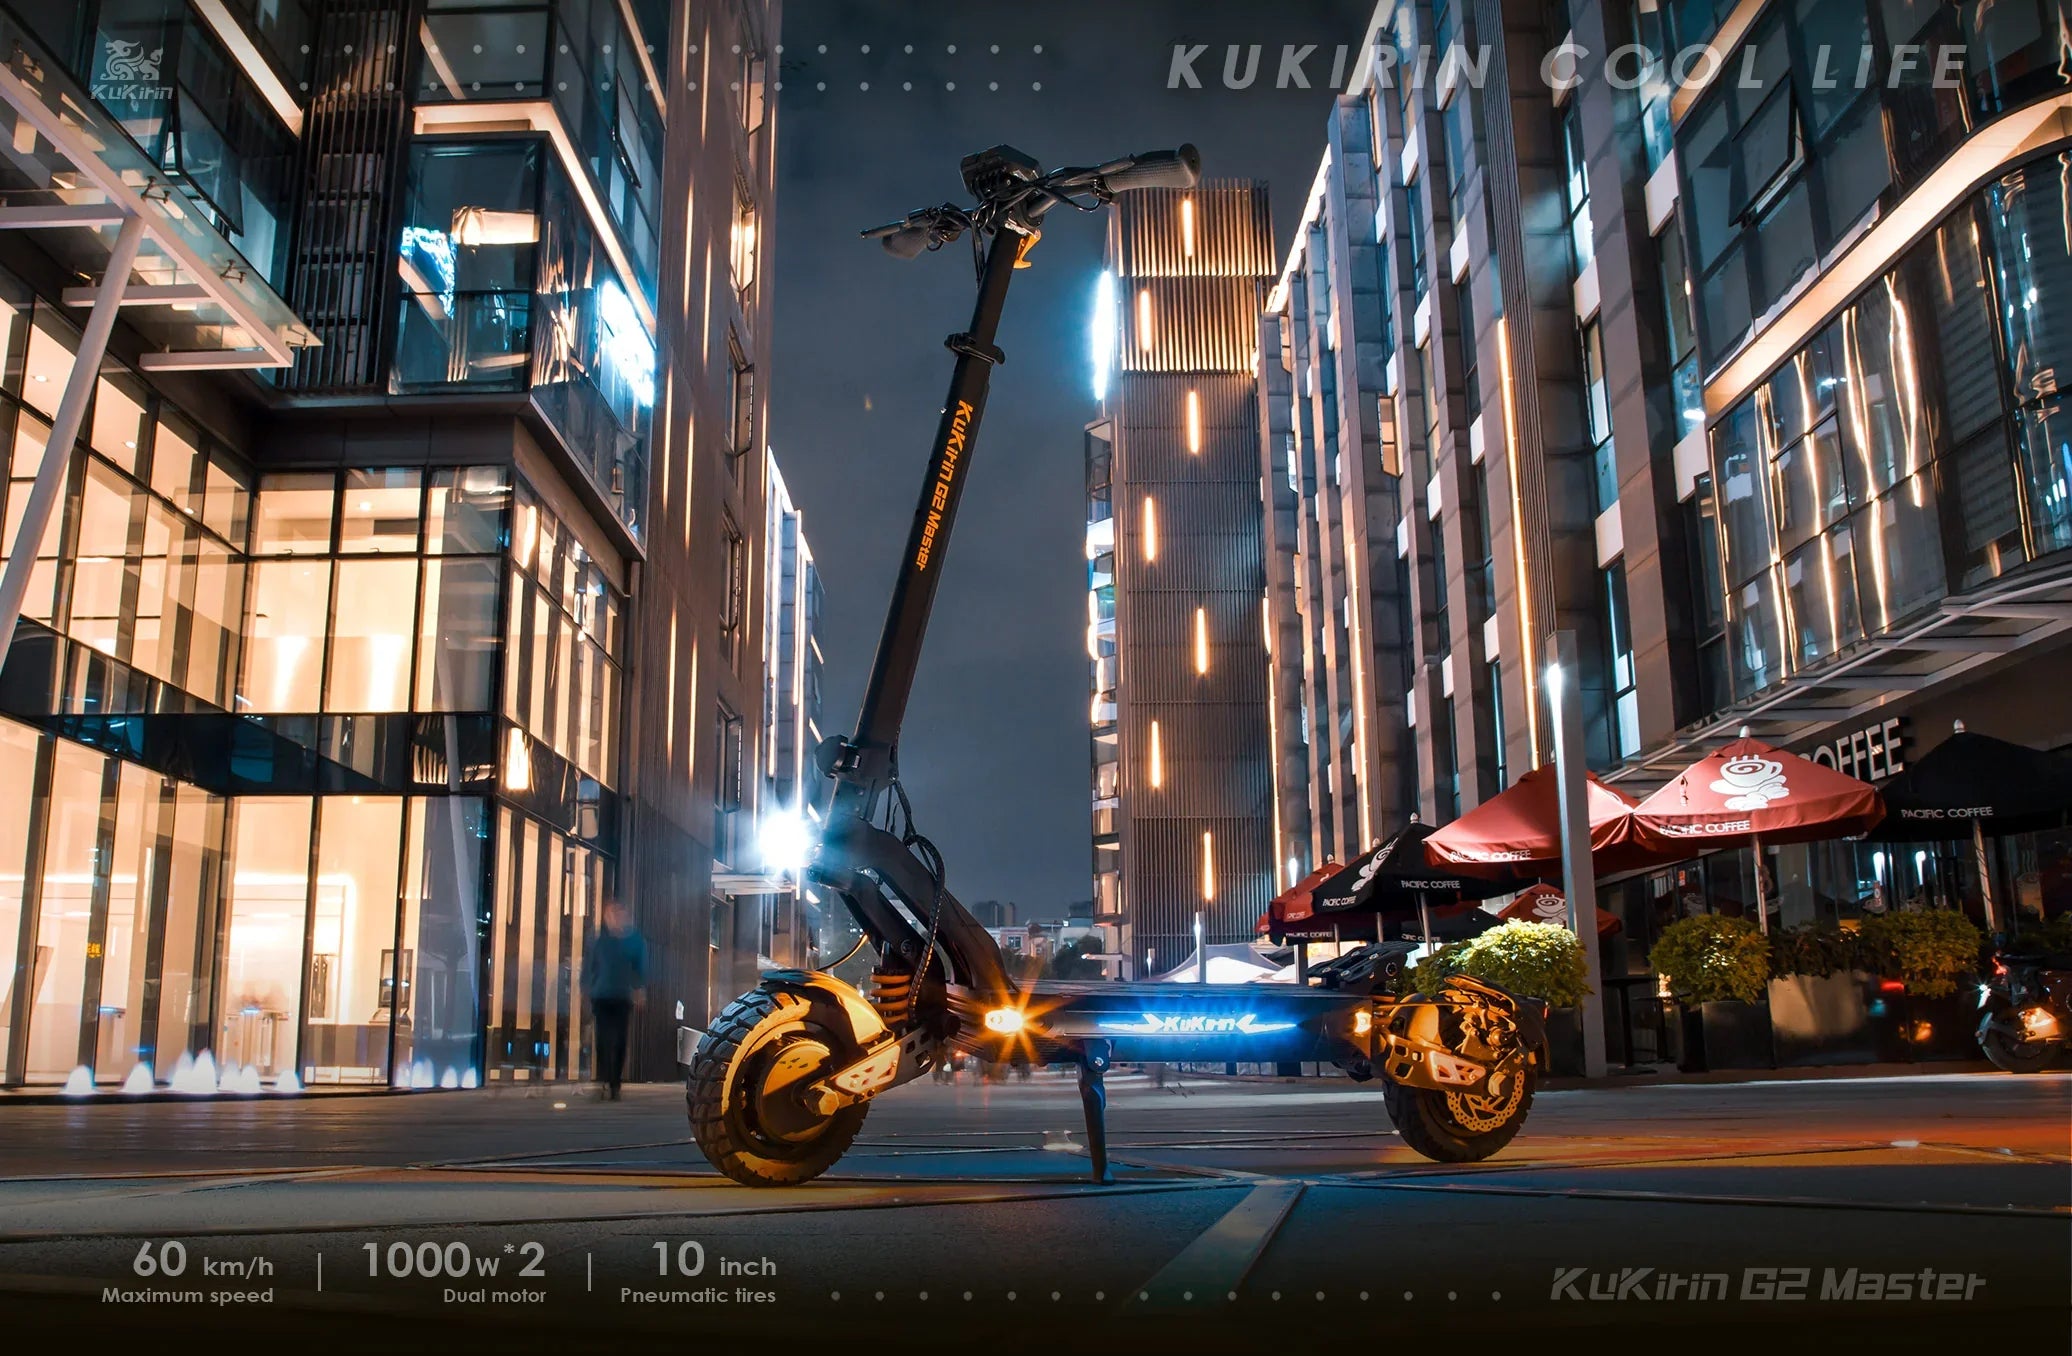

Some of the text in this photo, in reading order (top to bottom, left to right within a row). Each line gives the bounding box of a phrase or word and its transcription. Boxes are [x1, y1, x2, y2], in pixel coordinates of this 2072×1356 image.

[916, 400, 973, 571] KuKirin G2 Master
[1798, 717, 1903, 781] FFEE
[1901, 806, 1994, 819] PACIFIC COFFEE
[1705, 820, 1750, 833] COFFEE
[1430, 880, 1461, 889] COFFEE
